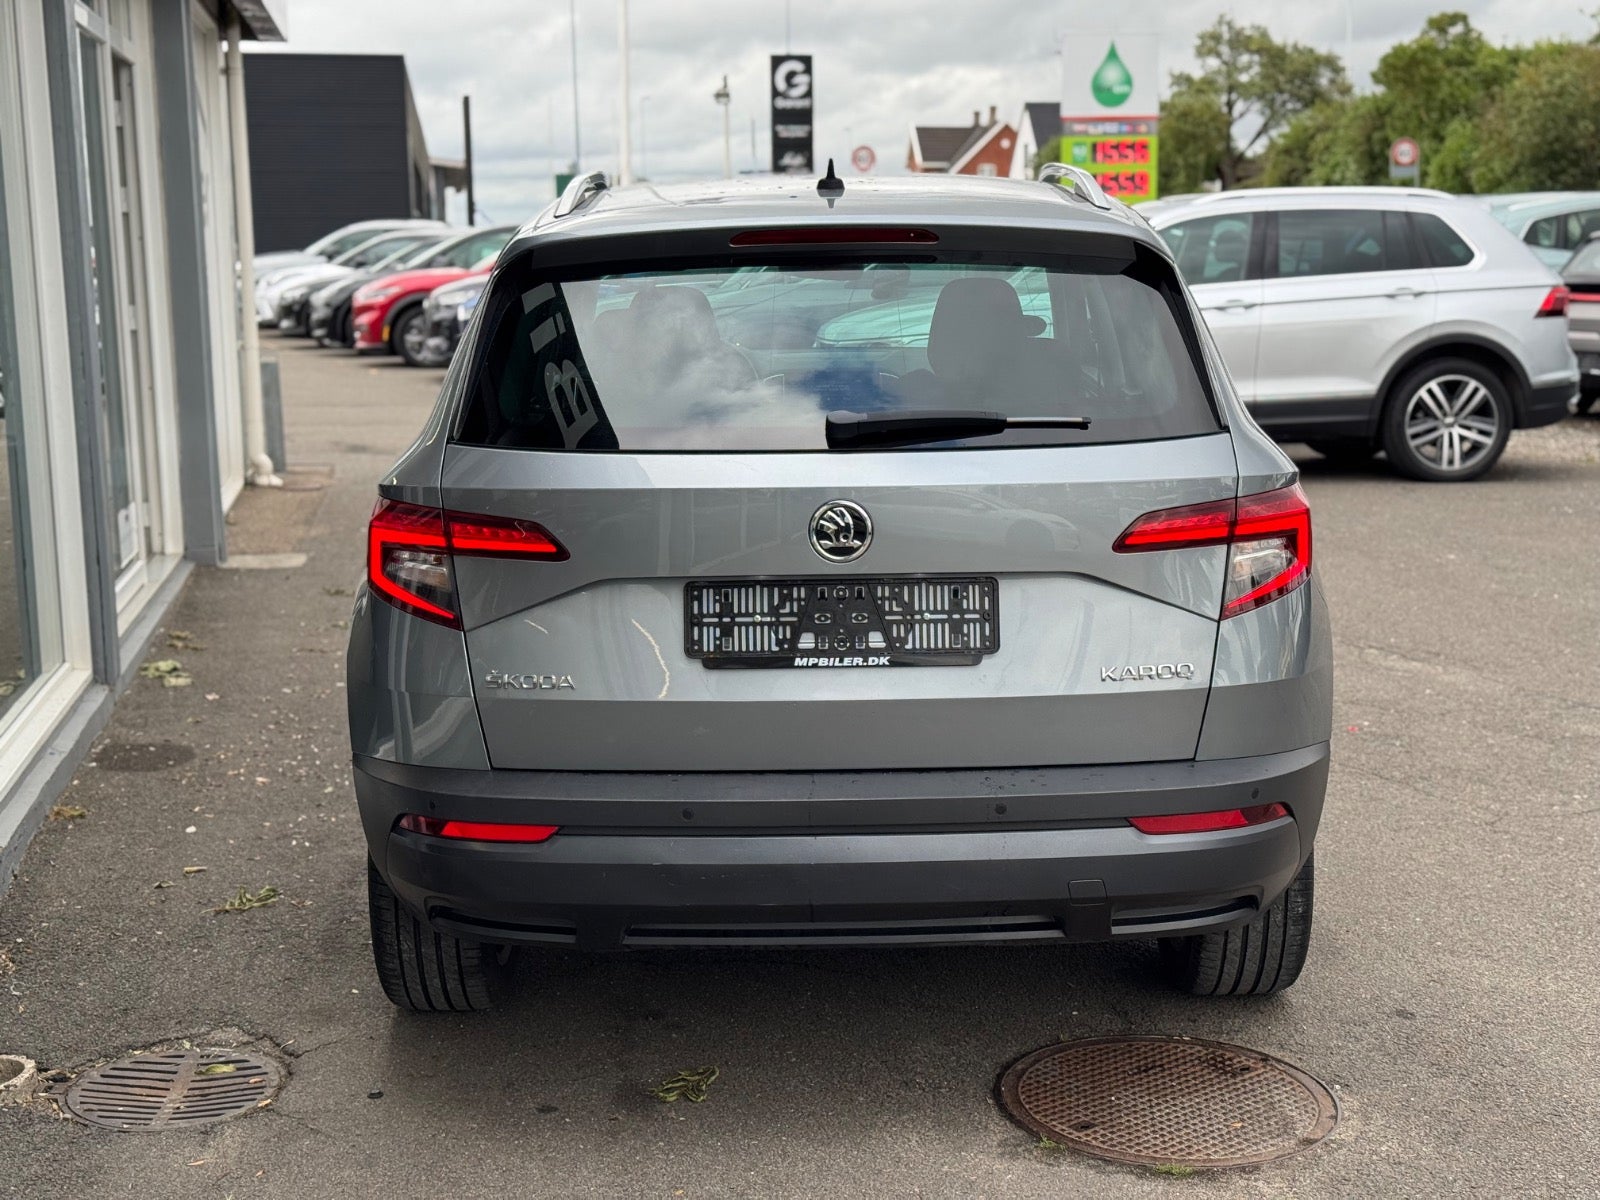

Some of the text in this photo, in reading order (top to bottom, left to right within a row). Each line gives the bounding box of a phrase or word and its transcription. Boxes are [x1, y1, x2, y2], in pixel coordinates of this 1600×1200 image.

[794, 656, 891, 667] MPBILER.DK
[485, 669, 576, 690] ŠKODA
[1101, 662, 1195, 682] KAROQ
